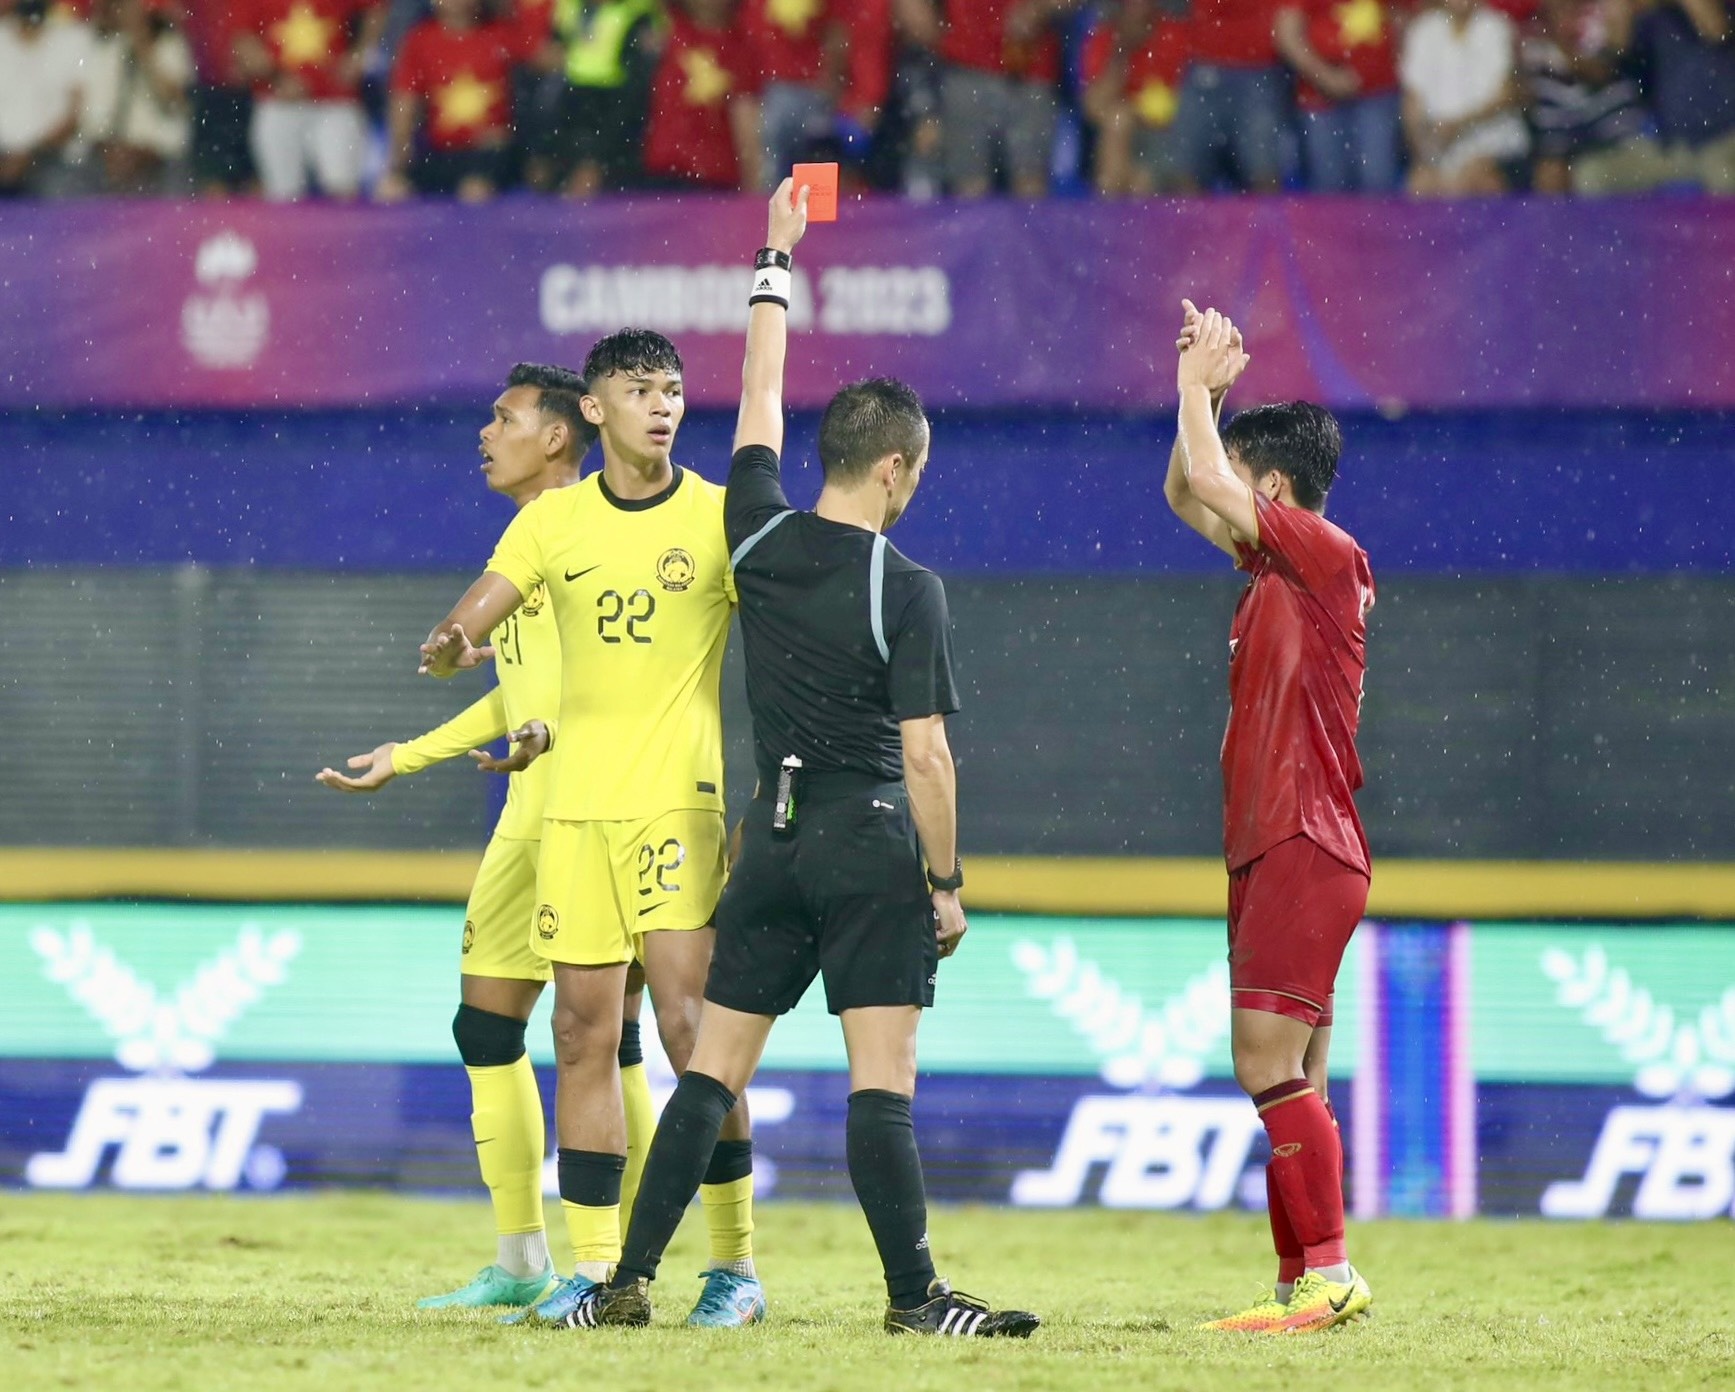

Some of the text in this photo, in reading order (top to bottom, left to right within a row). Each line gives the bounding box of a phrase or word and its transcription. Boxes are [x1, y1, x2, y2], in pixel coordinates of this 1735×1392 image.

[541, 266, 950, 333] CAMBODA 2023
[497, 614, 522, 665] 21
[597, 589, 655, 643] 22
[638, 838, 686, 896] 22
[1540, 1105, 1735, 1221] FB
